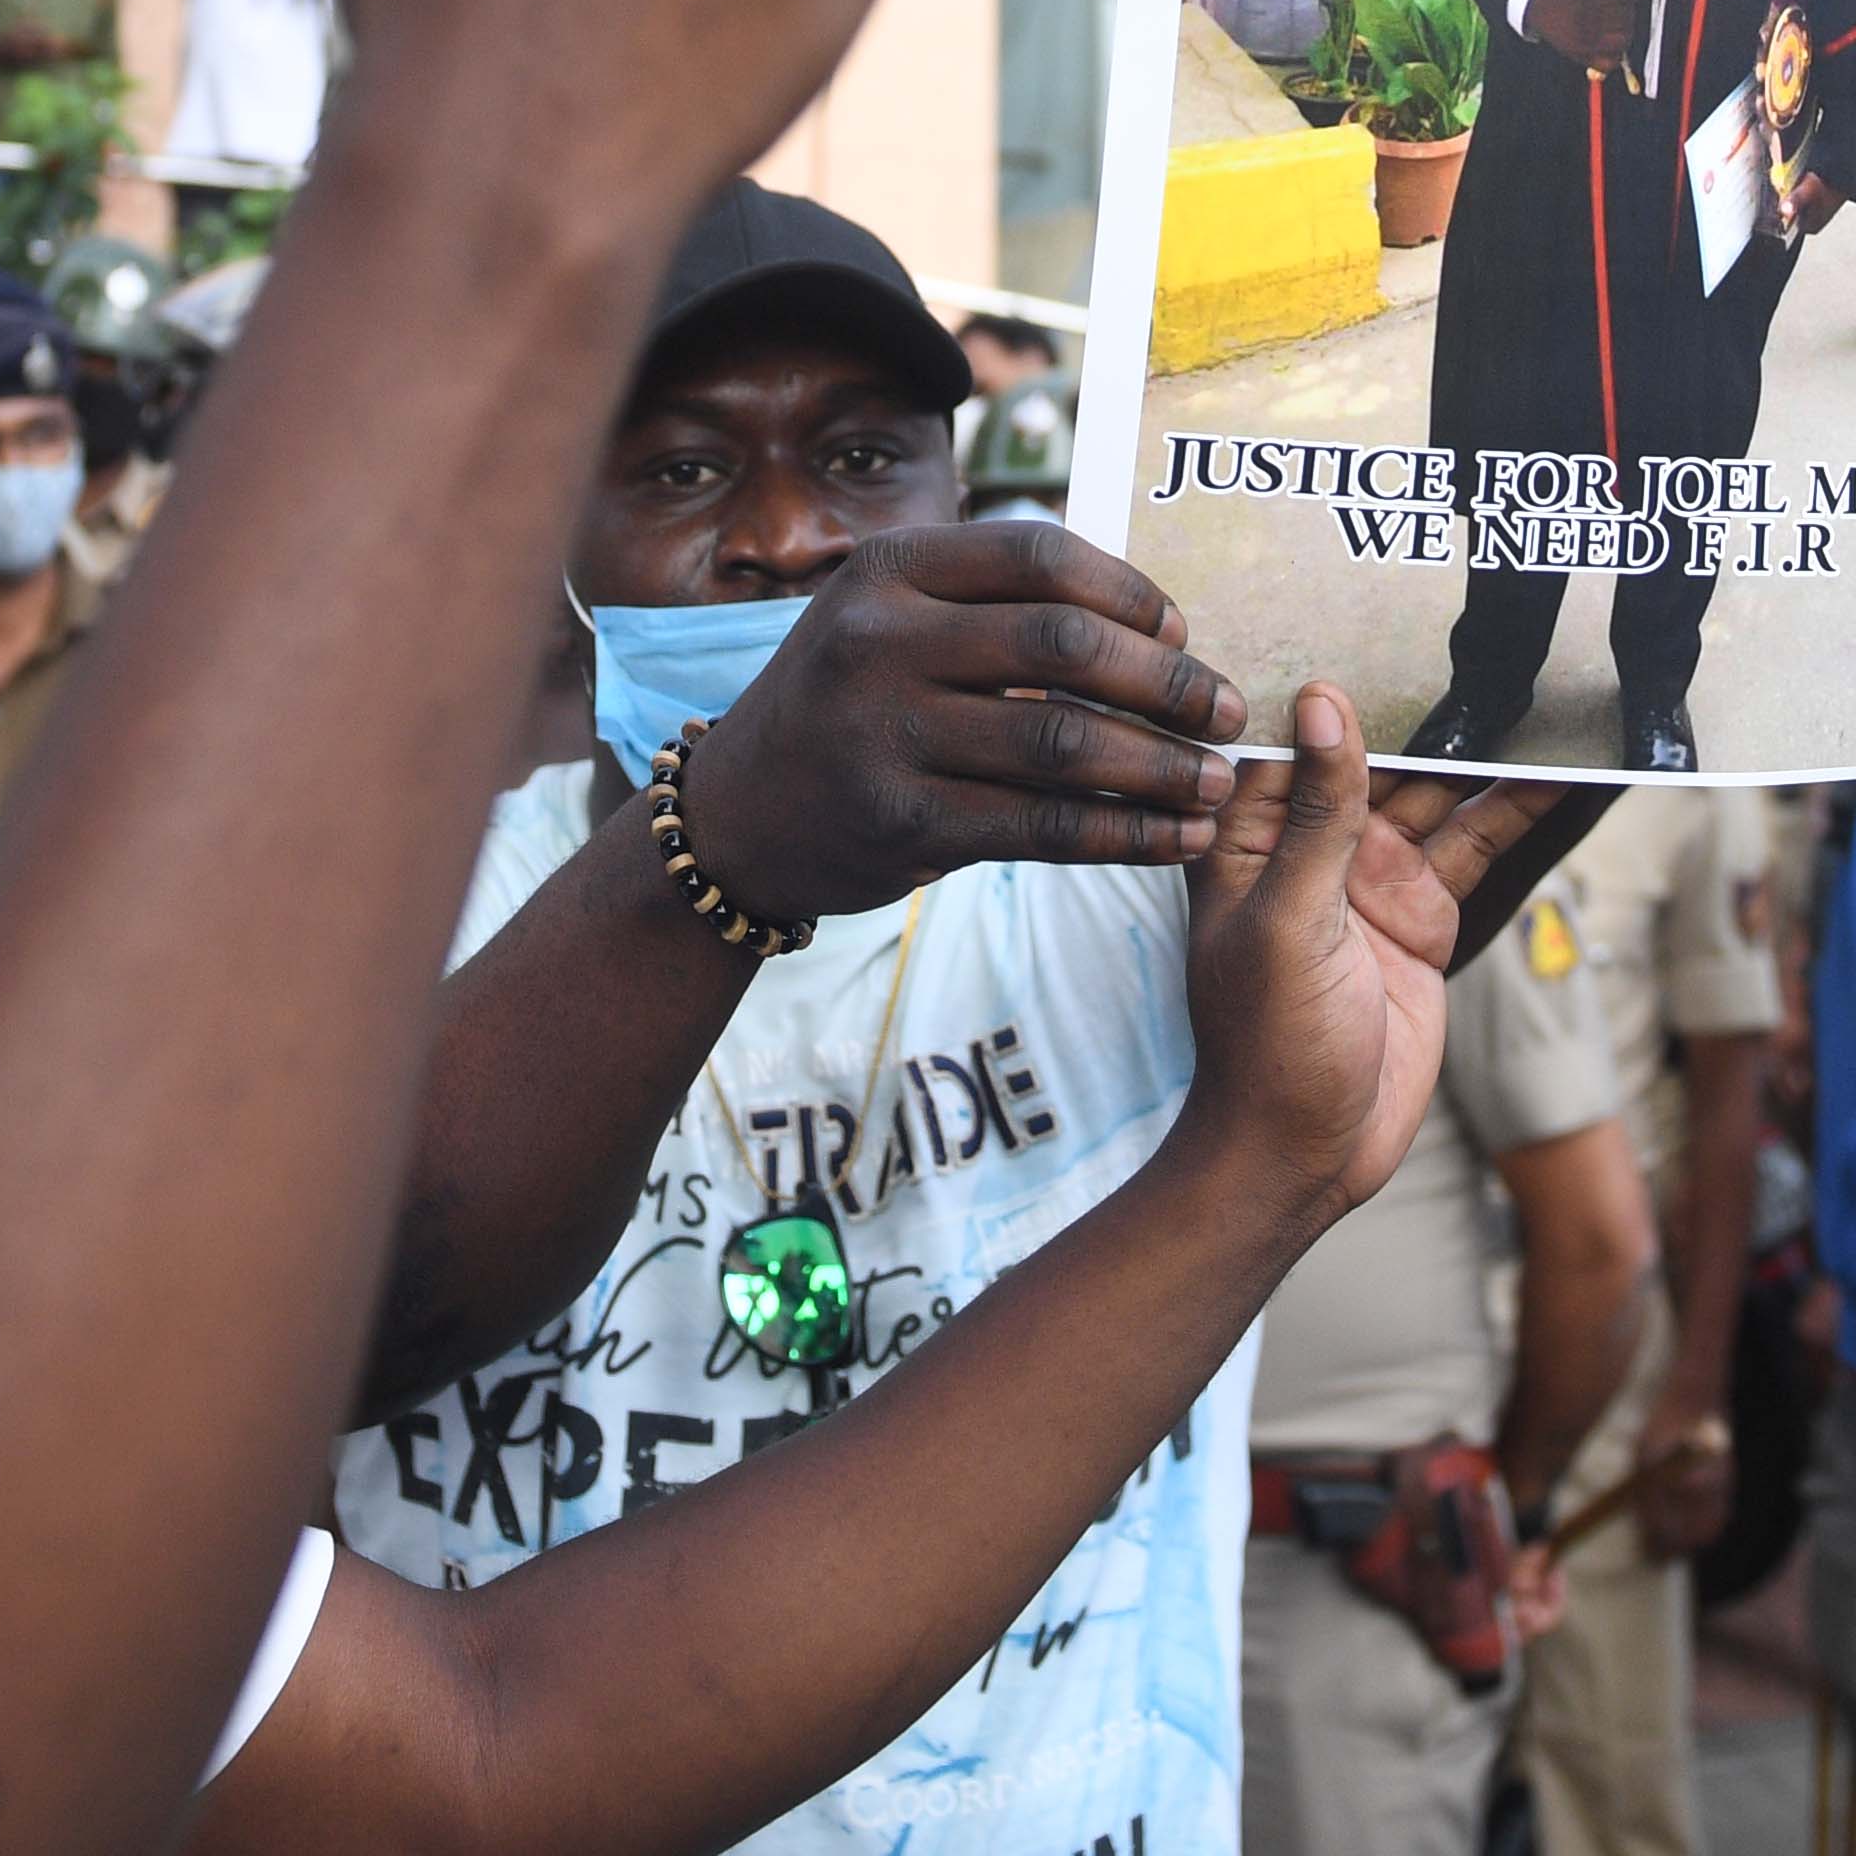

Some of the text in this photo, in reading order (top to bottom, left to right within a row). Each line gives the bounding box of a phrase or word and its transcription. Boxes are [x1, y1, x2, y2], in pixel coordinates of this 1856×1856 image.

[1150, 433, 1455, 502] JUSTICE
[1474, 452, 1622, 512] FOR
[1639, 457, 1789, 522] JOEL
[1331, 504, 1453, 565] WE
[1473, 512, 1668, 572] NEED
[746, 1024, 1058, 1220] TRADE
